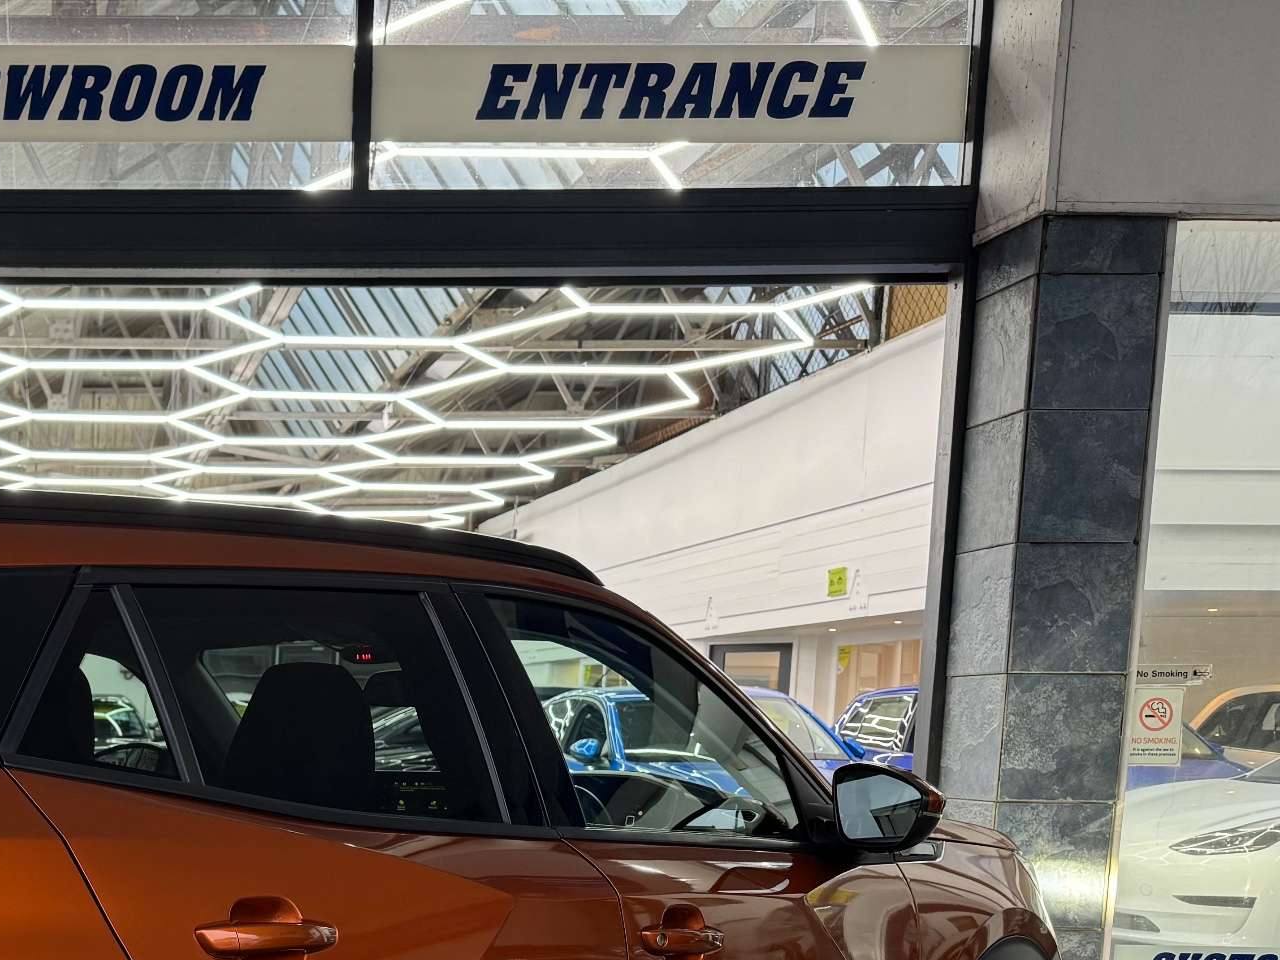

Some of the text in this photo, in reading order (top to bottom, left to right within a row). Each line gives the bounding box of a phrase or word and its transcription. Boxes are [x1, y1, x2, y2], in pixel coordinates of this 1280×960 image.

[475, 61, 867, 120] ENTRANCE
[1136, 670, 1189, 679] No Smoking
